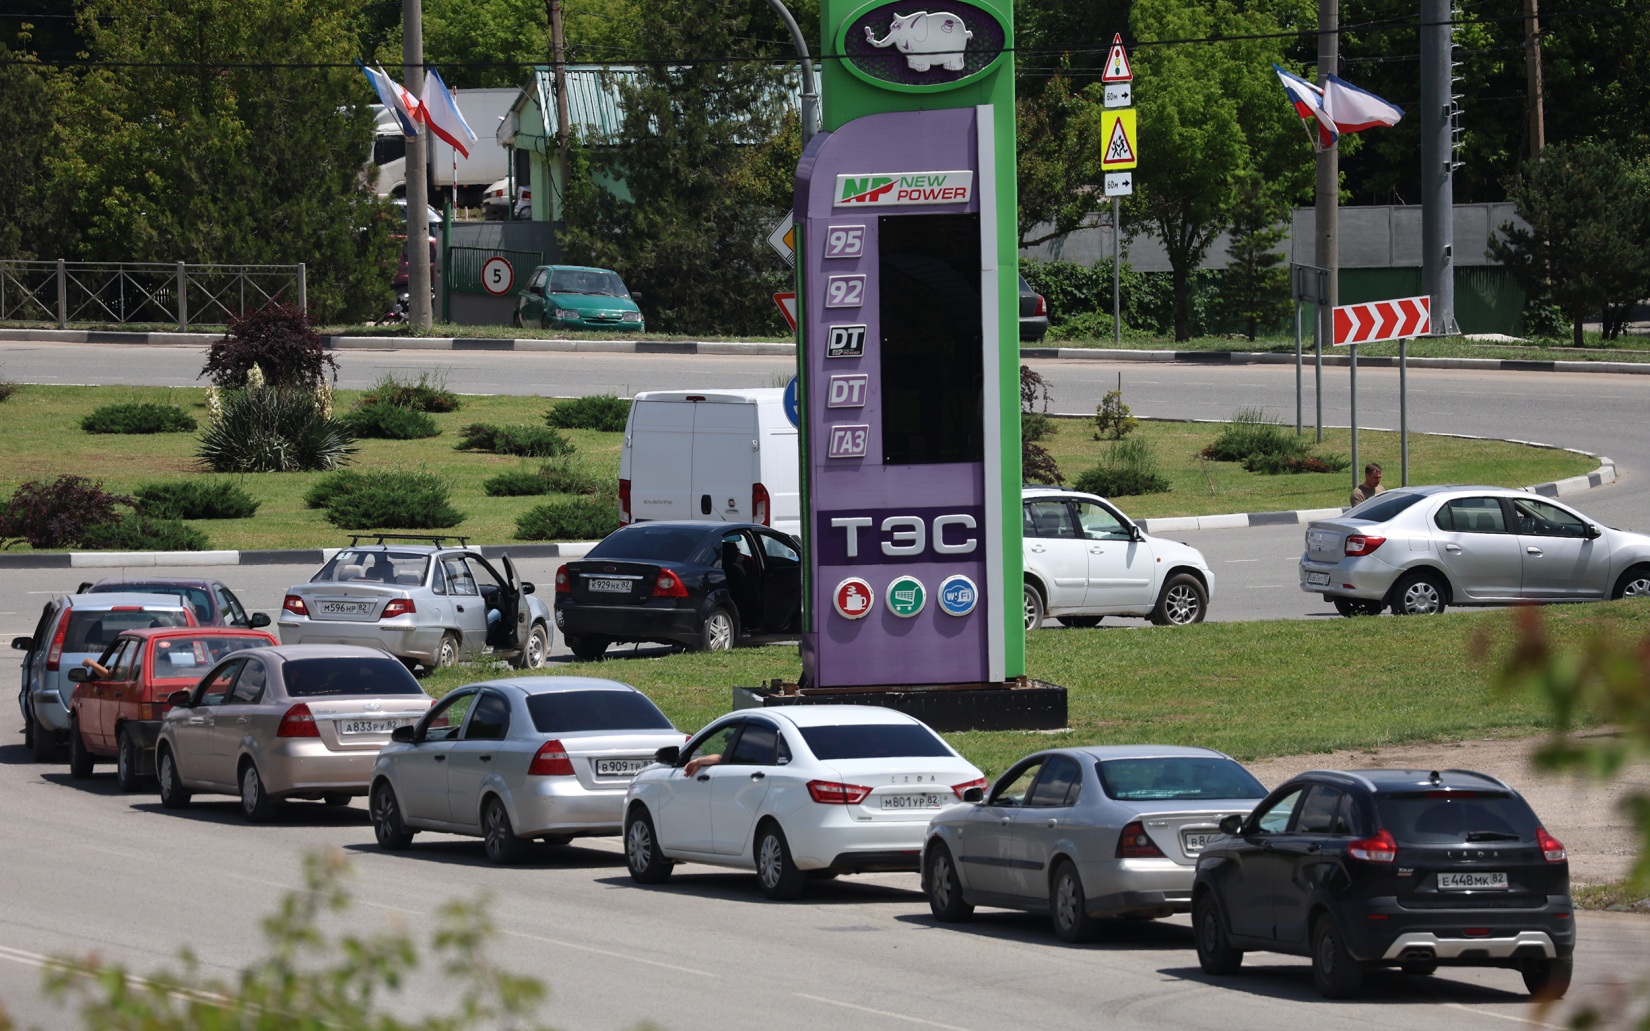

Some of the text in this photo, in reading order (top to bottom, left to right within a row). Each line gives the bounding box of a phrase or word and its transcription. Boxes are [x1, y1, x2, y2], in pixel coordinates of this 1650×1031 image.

[840, 176, 897, 203] NP
[900, 175, 948, 188] NEW
[897, 187, 967, 202] POWER
[829, 230, 863, 254] 95
[493, 268, 502, 284] 5
[830, 279, 863, 304] 92
[829, 327, 865, 350] DT
[830, 379, 866, 404] DT
[831, 430, 866, 454] ГАЗ
[830, 513, 978, 558] ТЭС
[1442, 873, 1504, 887] Е448МК 82
